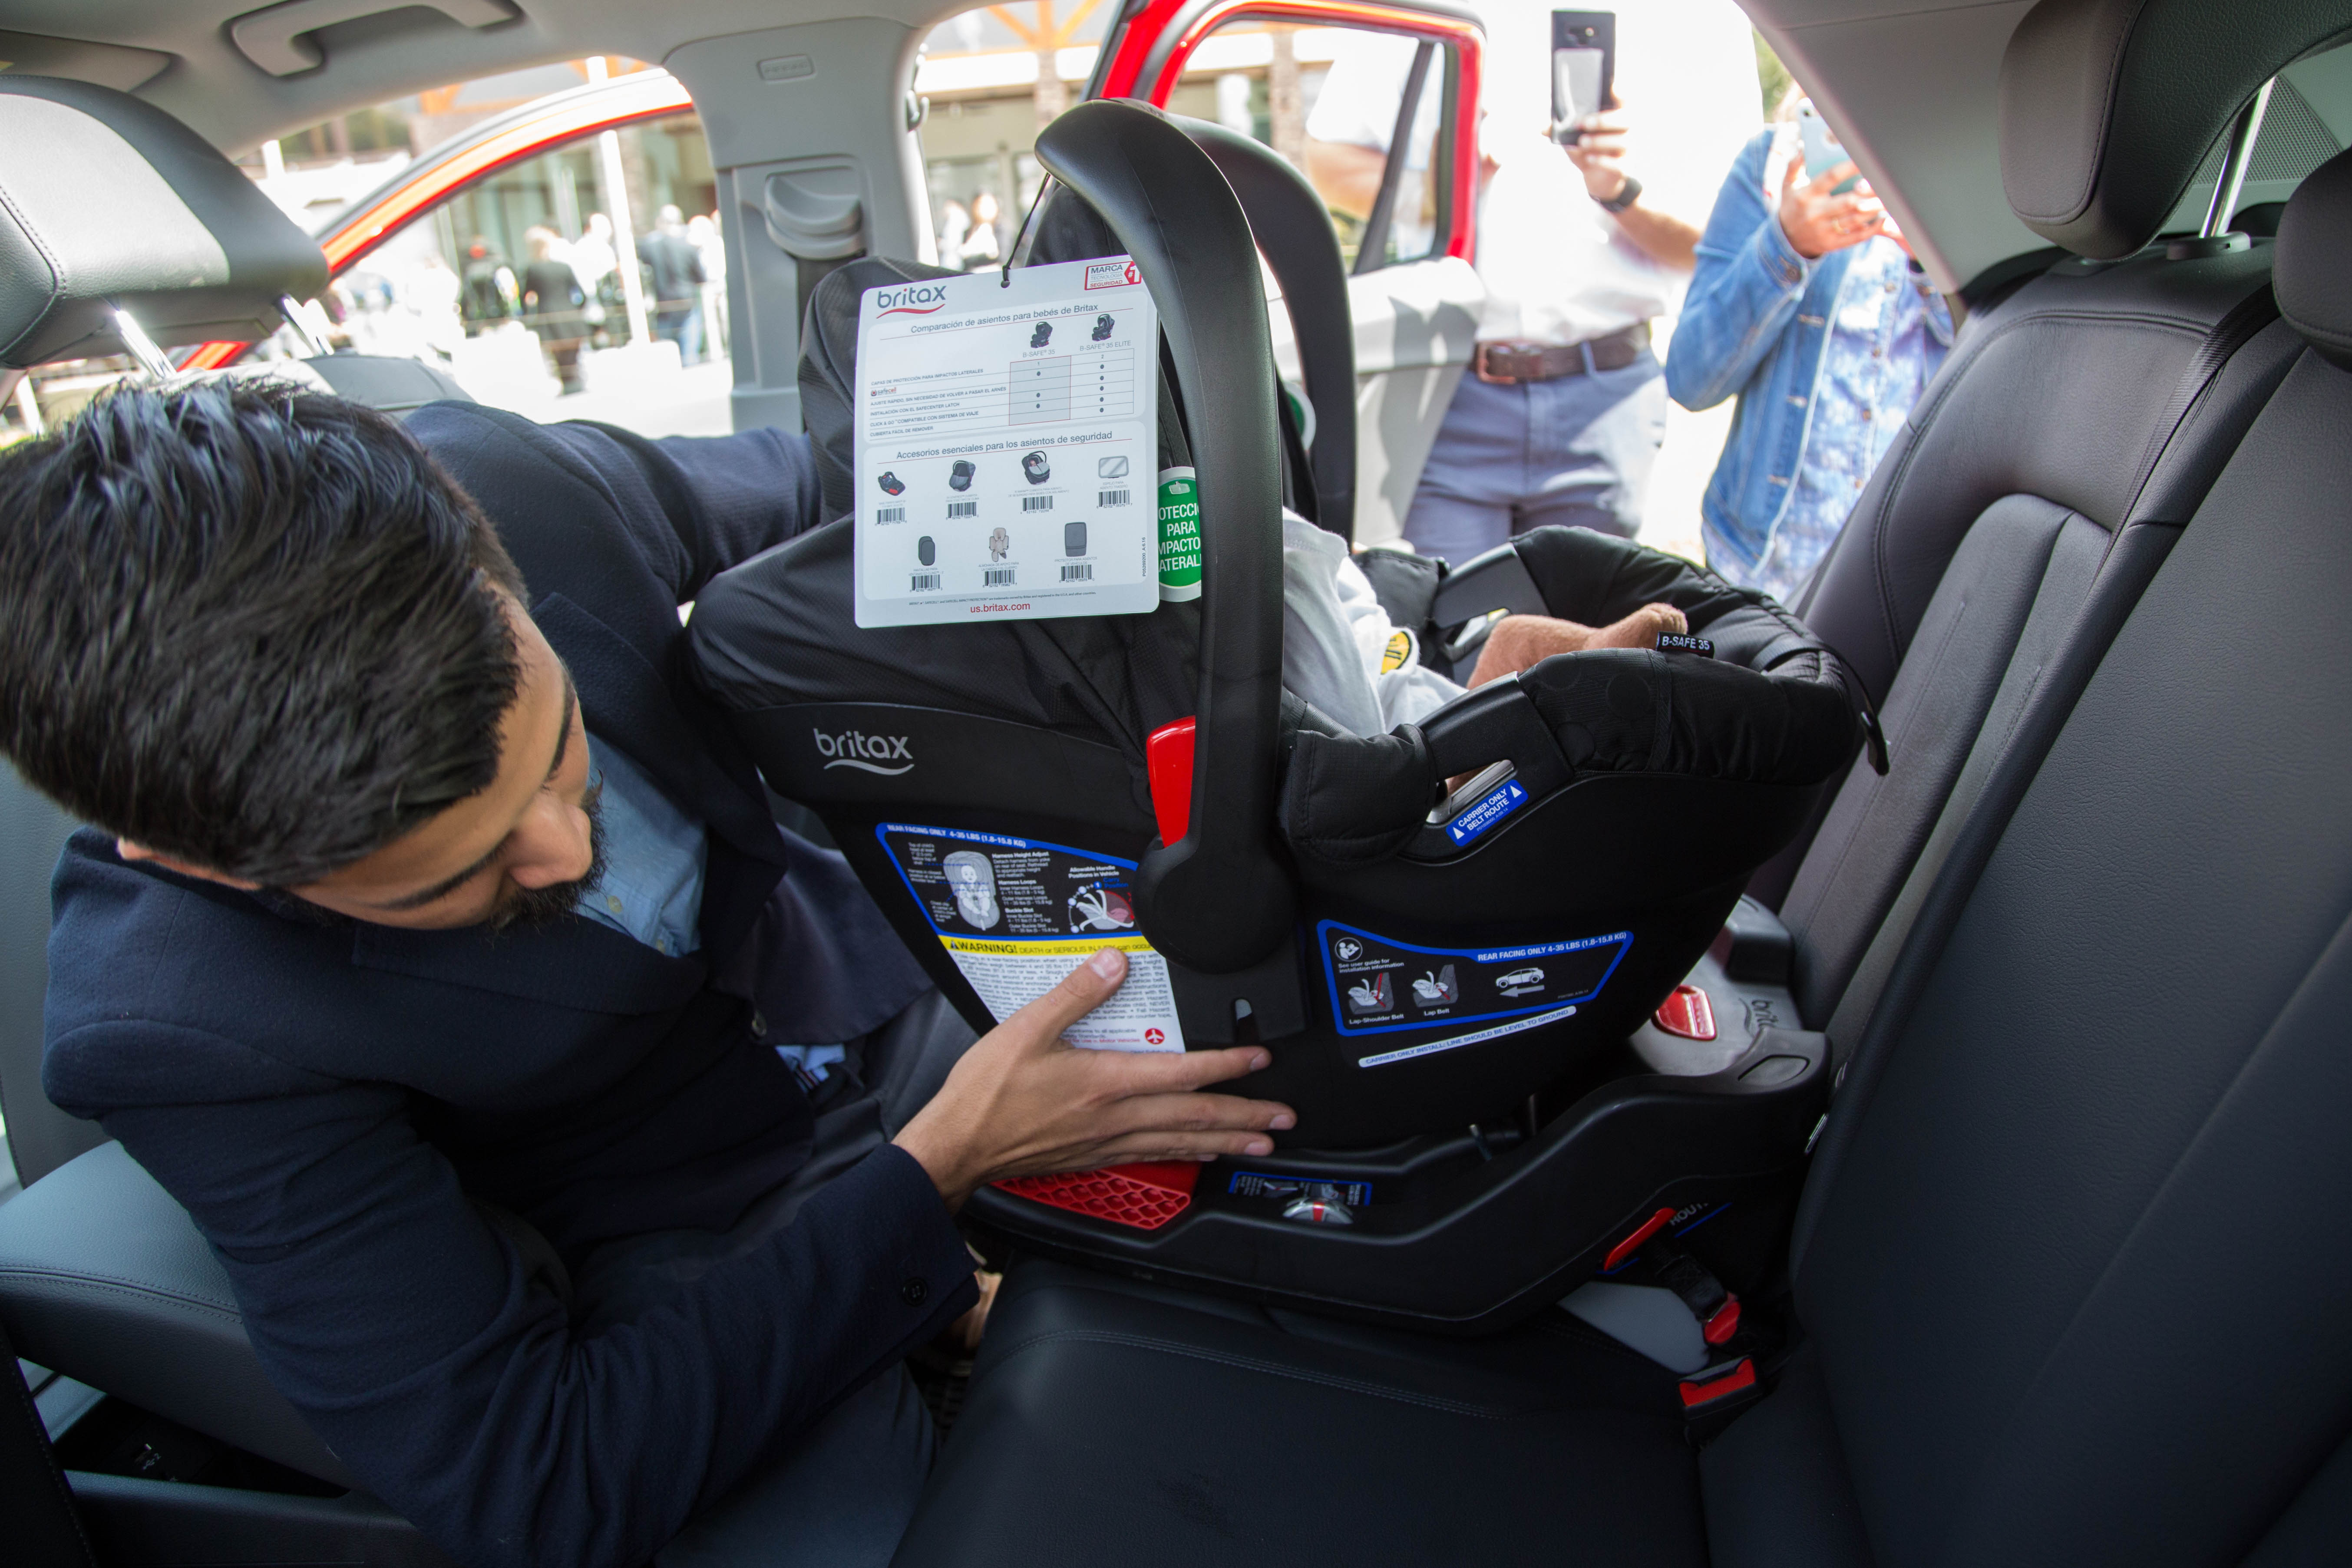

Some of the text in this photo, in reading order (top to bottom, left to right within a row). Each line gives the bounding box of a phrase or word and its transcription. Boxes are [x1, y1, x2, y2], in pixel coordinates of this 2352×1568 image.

[1091, 264, 1123, 274] MARCA
[877, 286, 947, 308] britax
[912, 303, 1098, 335] Comparación de asientos para bebés de Britax
[897, 448, 939, 459] Accesorios
[942, 443, 983, 454] esenciales
[986, 443, 1004, 452] para
[1021, 437, 1054, 447] asientos
[1070, 431, 1112, 444] seguridad
[1159, 503, 1199, 520] OTECCI
[1166, 521, 1196, 536] PARA
[1158, 537, 1200, 555] MPACTO
[1159, 554, 1201, 572] ATERAL
[970, 604, 1030, 613] us.britax.com
[1662, 636, 1710, 650] B-SAFE 35
[813, 728, 913, 759] britax
[1458, 789, 1507, 827] CARRIER ONLY
[1467, 798, 1510, 831] BELT ROUTE
[958, 941, 1017, 953] WARNING!
[1478, 952, 1497, 961] REAR
[1499, 949, 1526, 959] FACING
[1528, 947, 1546, 955] ONLY
[1582, 936, 1613, 948] (1.8-15.8
[1615, 932, 1627, 941] KG)
[1349, 1016, 1390, 1024] Lap-Shoulder
[1366, 1053, 1396, 1064] CARRIER
[1397, 1049, 1415, 1057] ONLY
[1447, 1038, 1463, 1046] LINE
[1464, 1031, 1493, 1042] SHOULD
[1505, 1023, 1525, 1032] LEVEL
[1538, 1009, 1569, 1023] GROUND
